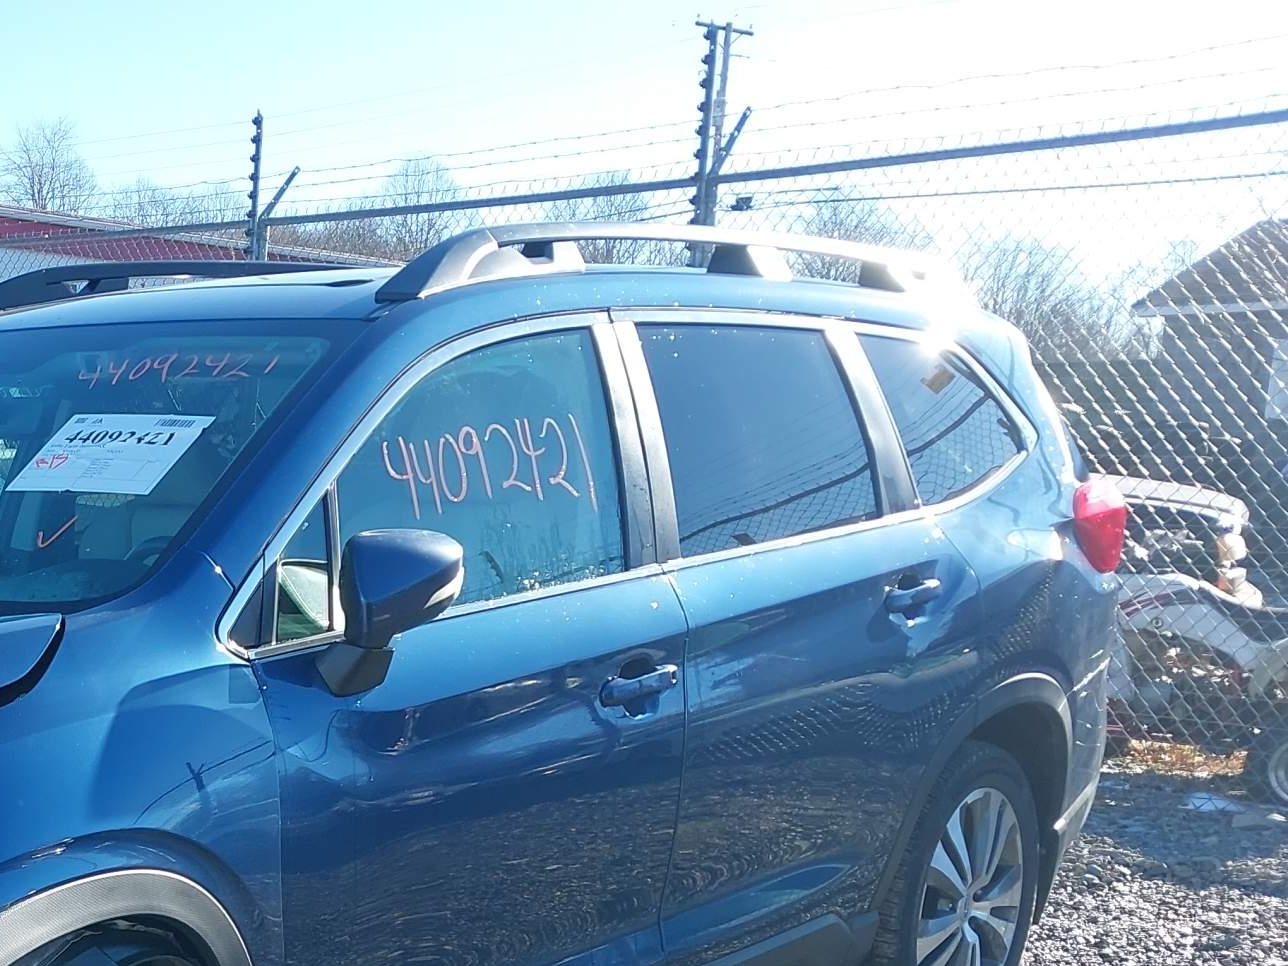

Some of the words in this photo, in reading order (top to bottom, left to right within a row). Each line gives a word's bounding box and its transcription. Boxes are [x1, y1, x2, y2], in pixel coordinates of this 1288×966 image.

[78, 353, 280, 389] 44092421
[64, 429, 177, 446] 44092421
[382, 412, 598, 520] 44092421
